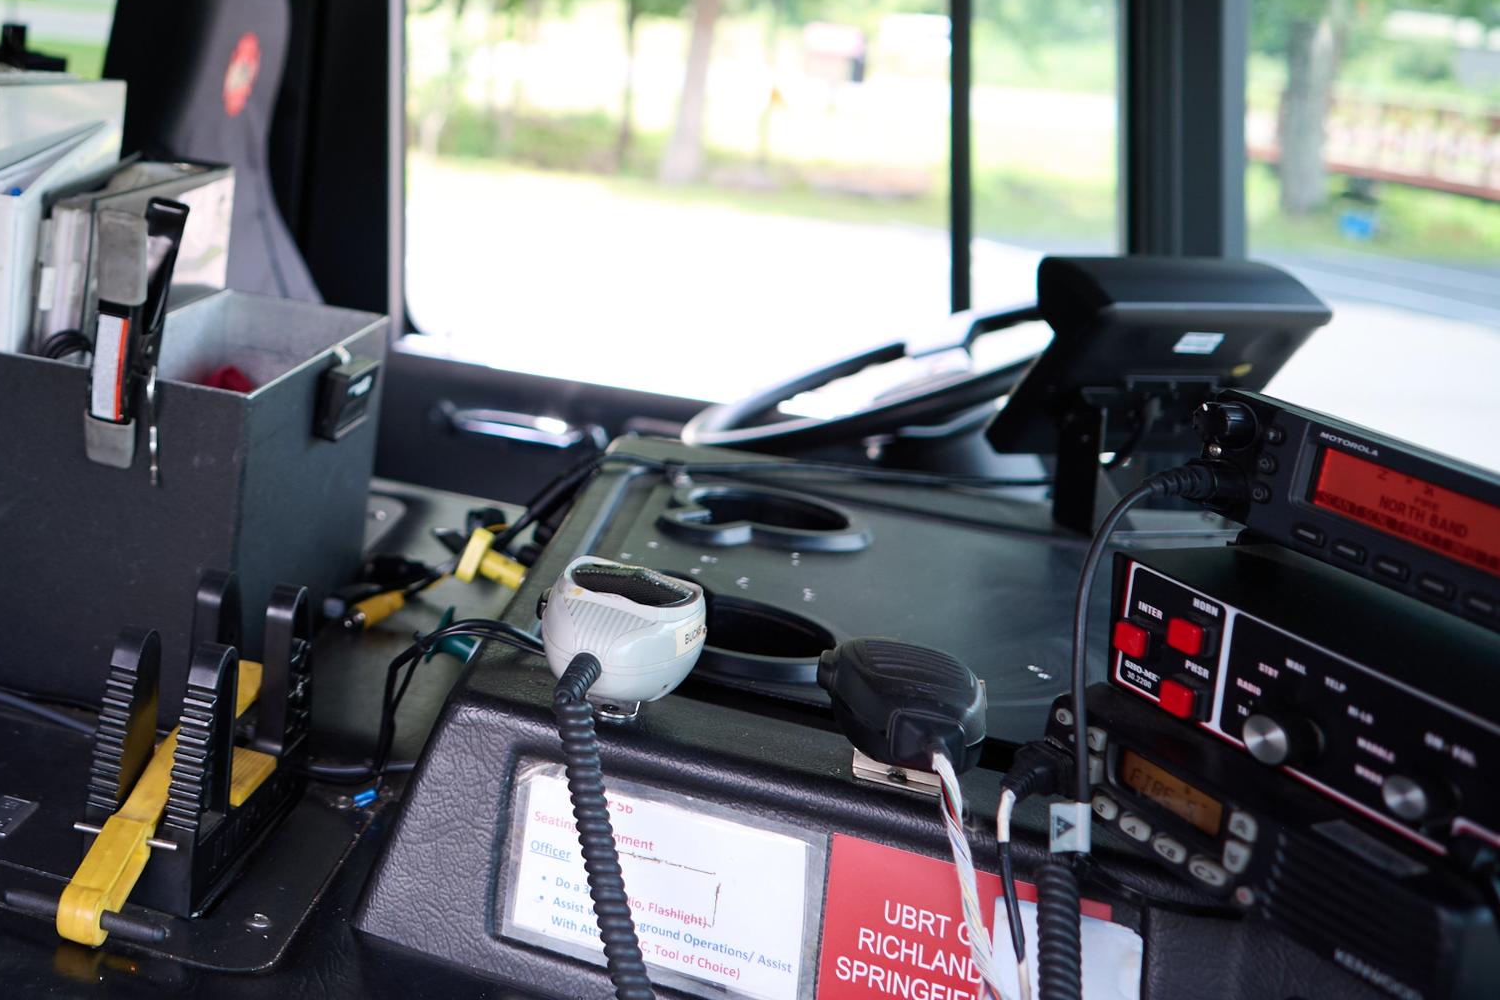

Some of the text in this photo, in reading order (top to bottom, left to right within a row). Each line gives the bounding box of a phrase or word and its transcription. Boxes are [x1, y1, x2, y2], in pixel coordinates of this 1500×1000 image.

[1318, 431, 1379, 457] MOTOROLA
[1379, 495, 1469, 539] NORTH BAND
[1137, 600, 1164, 620] INTER
[1192, 597, 1219, 618] HORN
[533, 811, 579, 834] Seating
[530, 840, 571, 860] Officer
[555, 876, 570, 889] Do
[573, 883, 580, 892] a
[647, 902, 708, 929] Flashlight)
[883, 899, 952, 938] UBRT
[551, 914, 577, 933] With
[580, 923, 603, 938] Atta
[654, 944, 680, 961] Tool
[682, 952, 696, 965] of
[697, 957, 742, 981] Choice)
[553, 897, 585, 914] Assist
[757, 954, 793, 974] Assist
